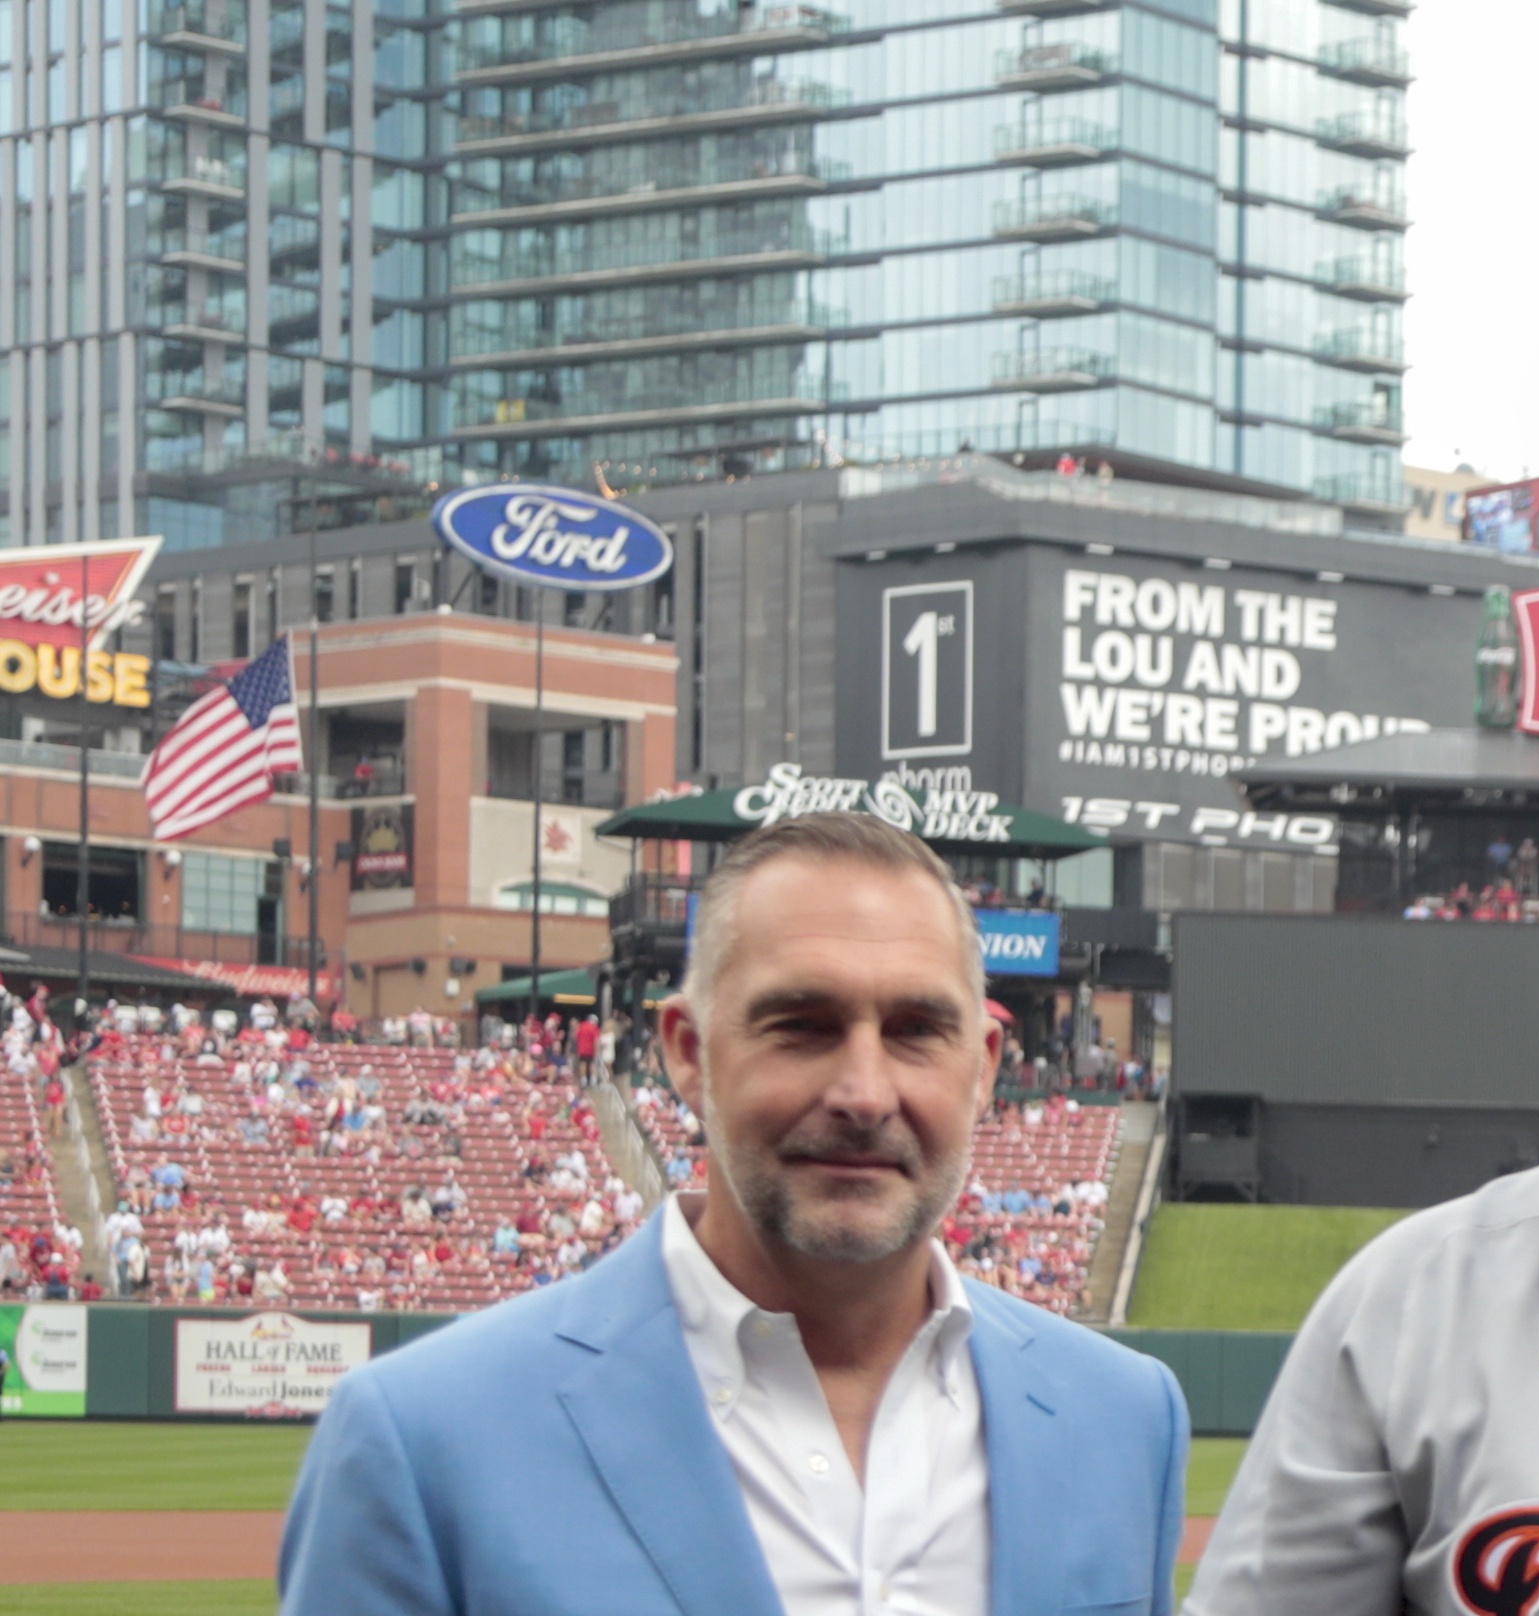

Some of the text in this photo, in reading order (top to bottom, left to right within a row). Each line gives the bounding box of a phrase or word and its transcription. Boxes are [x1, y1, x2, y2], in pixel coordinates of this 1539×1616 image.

[491, 496, 627, 574] Ford
[1064, 568, 1337, 651] FROM THE
[1064, 625, 1300, 699] LOU AND
[1059, 681, 1237, 750] WE'RE
[925, 790, 999, 815] MVP
[1061, 796, 1181, 829] 1ST
[922, 814, 1013, 842] DECK
[207, 1341, 264, 1361] HALL
[285, 1343, 343, 1362] FAME
[209, 1378, 277, 1398] Edward
